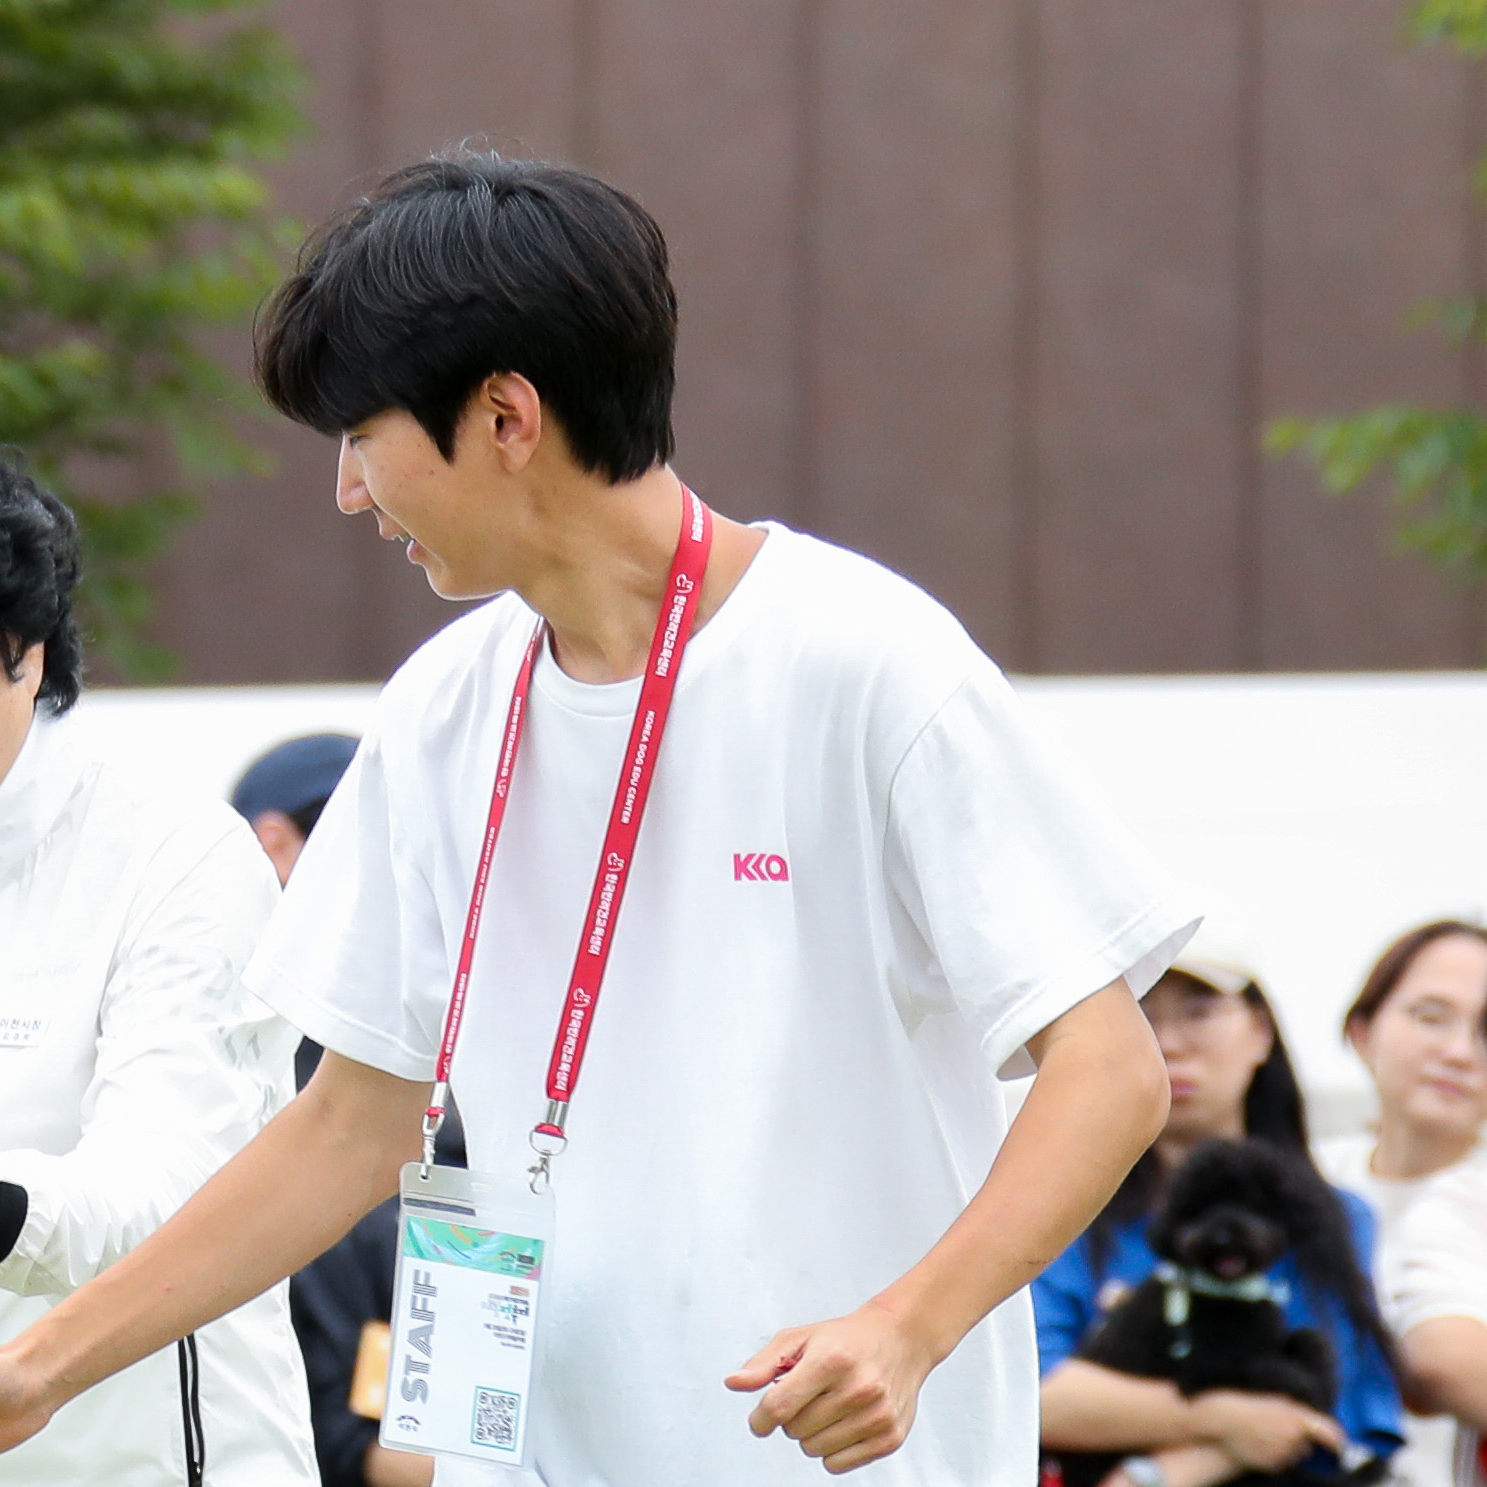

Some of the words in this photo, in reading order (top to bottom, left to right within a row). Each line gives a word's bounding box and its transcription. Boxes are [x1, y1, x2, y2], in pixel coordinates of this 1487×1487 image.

[639, 709, 656, 742] KOREA
[635, 743, 648, 766] DOG
[630, 766, 643, 787] EDU
[620, 787, 637, 824] CENTER
[399, 1268, 439, 1404] STAFF
